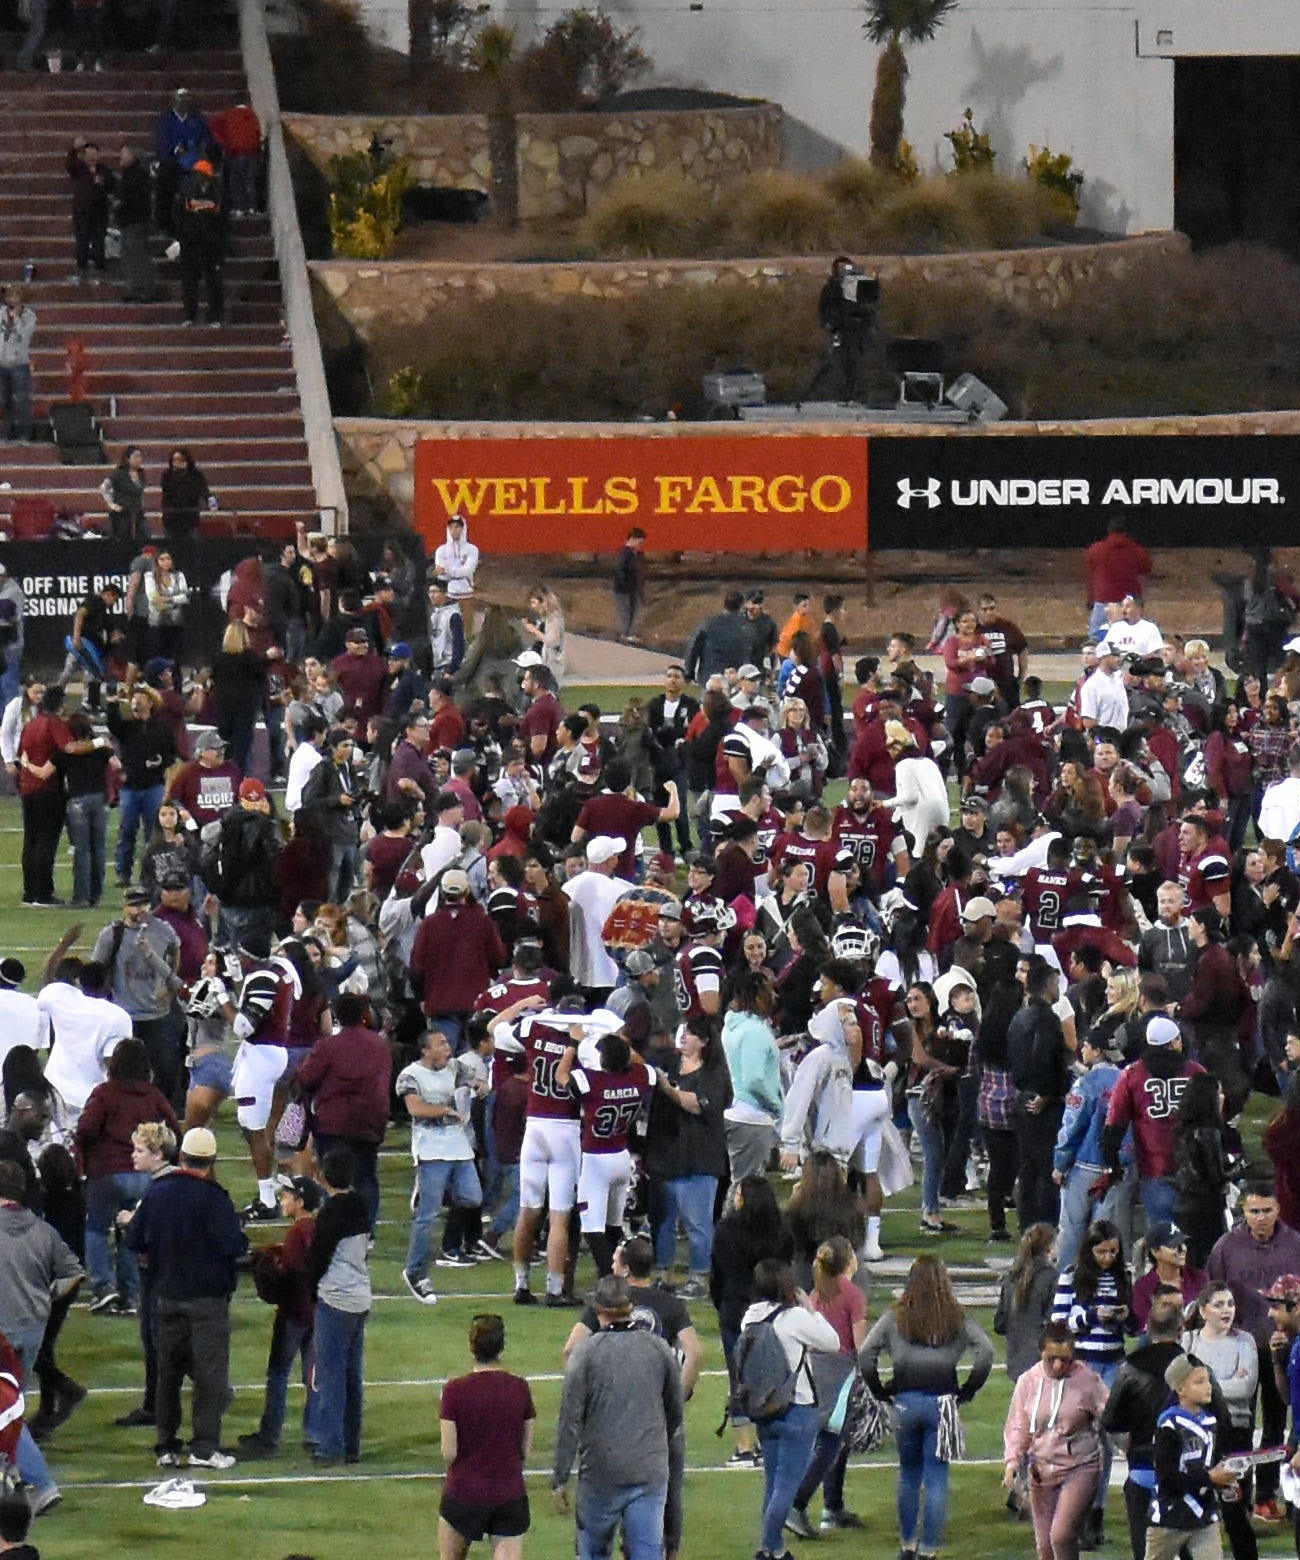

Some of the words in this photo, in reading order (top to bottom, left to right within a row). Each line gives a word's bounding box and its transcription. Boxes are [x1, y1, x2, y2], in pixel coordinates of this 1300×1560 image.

[430, 475, 640, 518] WELLS
[653, 473, 854, 516] FARGO
[951, 478, 1091, 506] UNDER
[23, 576, 53, 594] OFF
[57, 576, 89, 594] THE
[1038, 890, 1060, 928] 2
[604, 1087, 641, 1100] GARCIA
